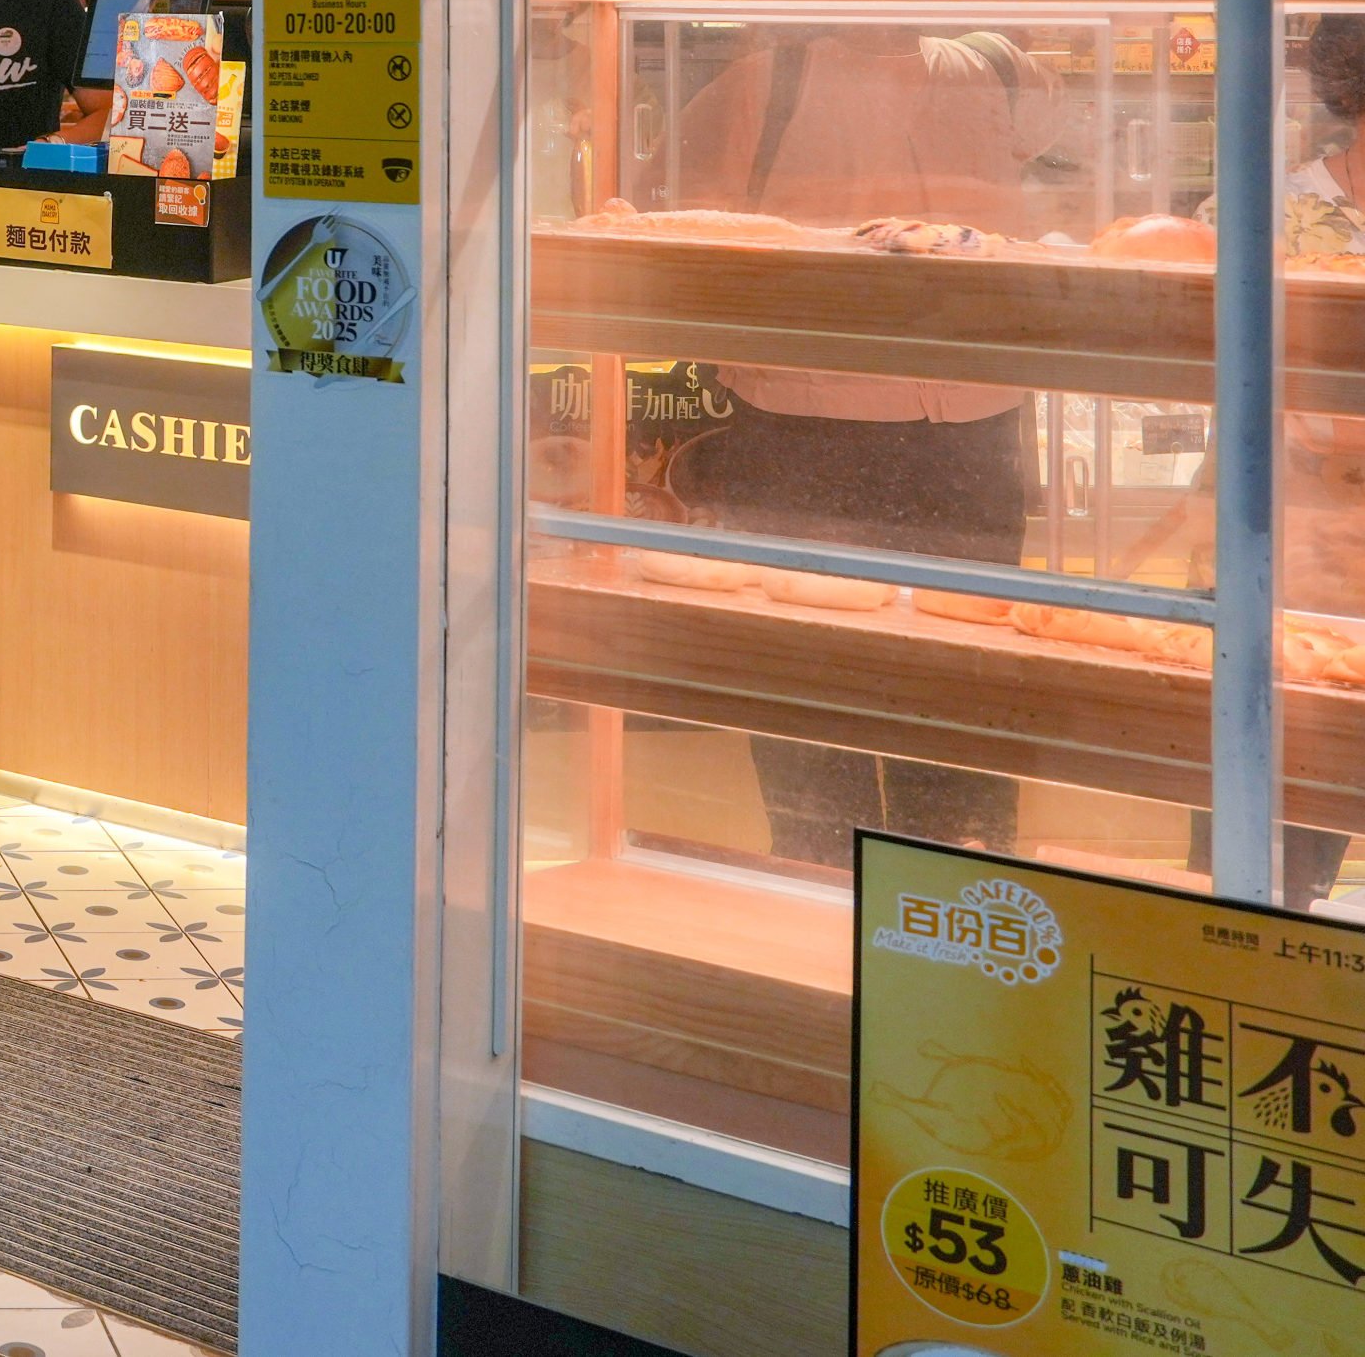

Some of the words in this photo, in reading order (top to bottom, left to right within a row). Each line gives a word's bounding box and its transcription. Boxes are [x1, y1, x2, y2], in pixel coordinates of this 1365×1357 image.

[312, 0, 343, 9] Business
[346, 0, 367, 9] Hours
[285, 12, 395, 35] 07:00-20:00
[127, 109, 211, 133] 買二送一
[269, 147, 322, 161] 本店已安裝
[5, 224, 91, 256] 麵包付款
[296, 277, 377, 305] FOOD
[291, 301, 374, 323] AWARDS
[311, 319, 358, 343] 2025
[300, 351, 370, 376] 得獎食肆
[901, 896, 1029, 957] 百份百
[875, 930, 913, 951] Make
[932, 941, 967, 962] fresh
[922, 1177, 1009, 1224] 推廣價
[904, 1208, 1008, 1277] $53
[912, 1266, 1013, 1312] 原價$68
[1061, 1297, 1076, 1313] 配
[1061, 1282, 1105, 1302] Chicken
[1108, 1296, 1133, 1311] with
[1136, 1302, 1182, 1325] Scallion
[1184, 1316, 1201, 1330] Oil
[1061, 1311, 1100, 1330] Served
[1103, 1323, 1128, 1338] with
[1130, 1329, 1155, 1347] Rice
[1159, 1337, 1180, 1354] and
